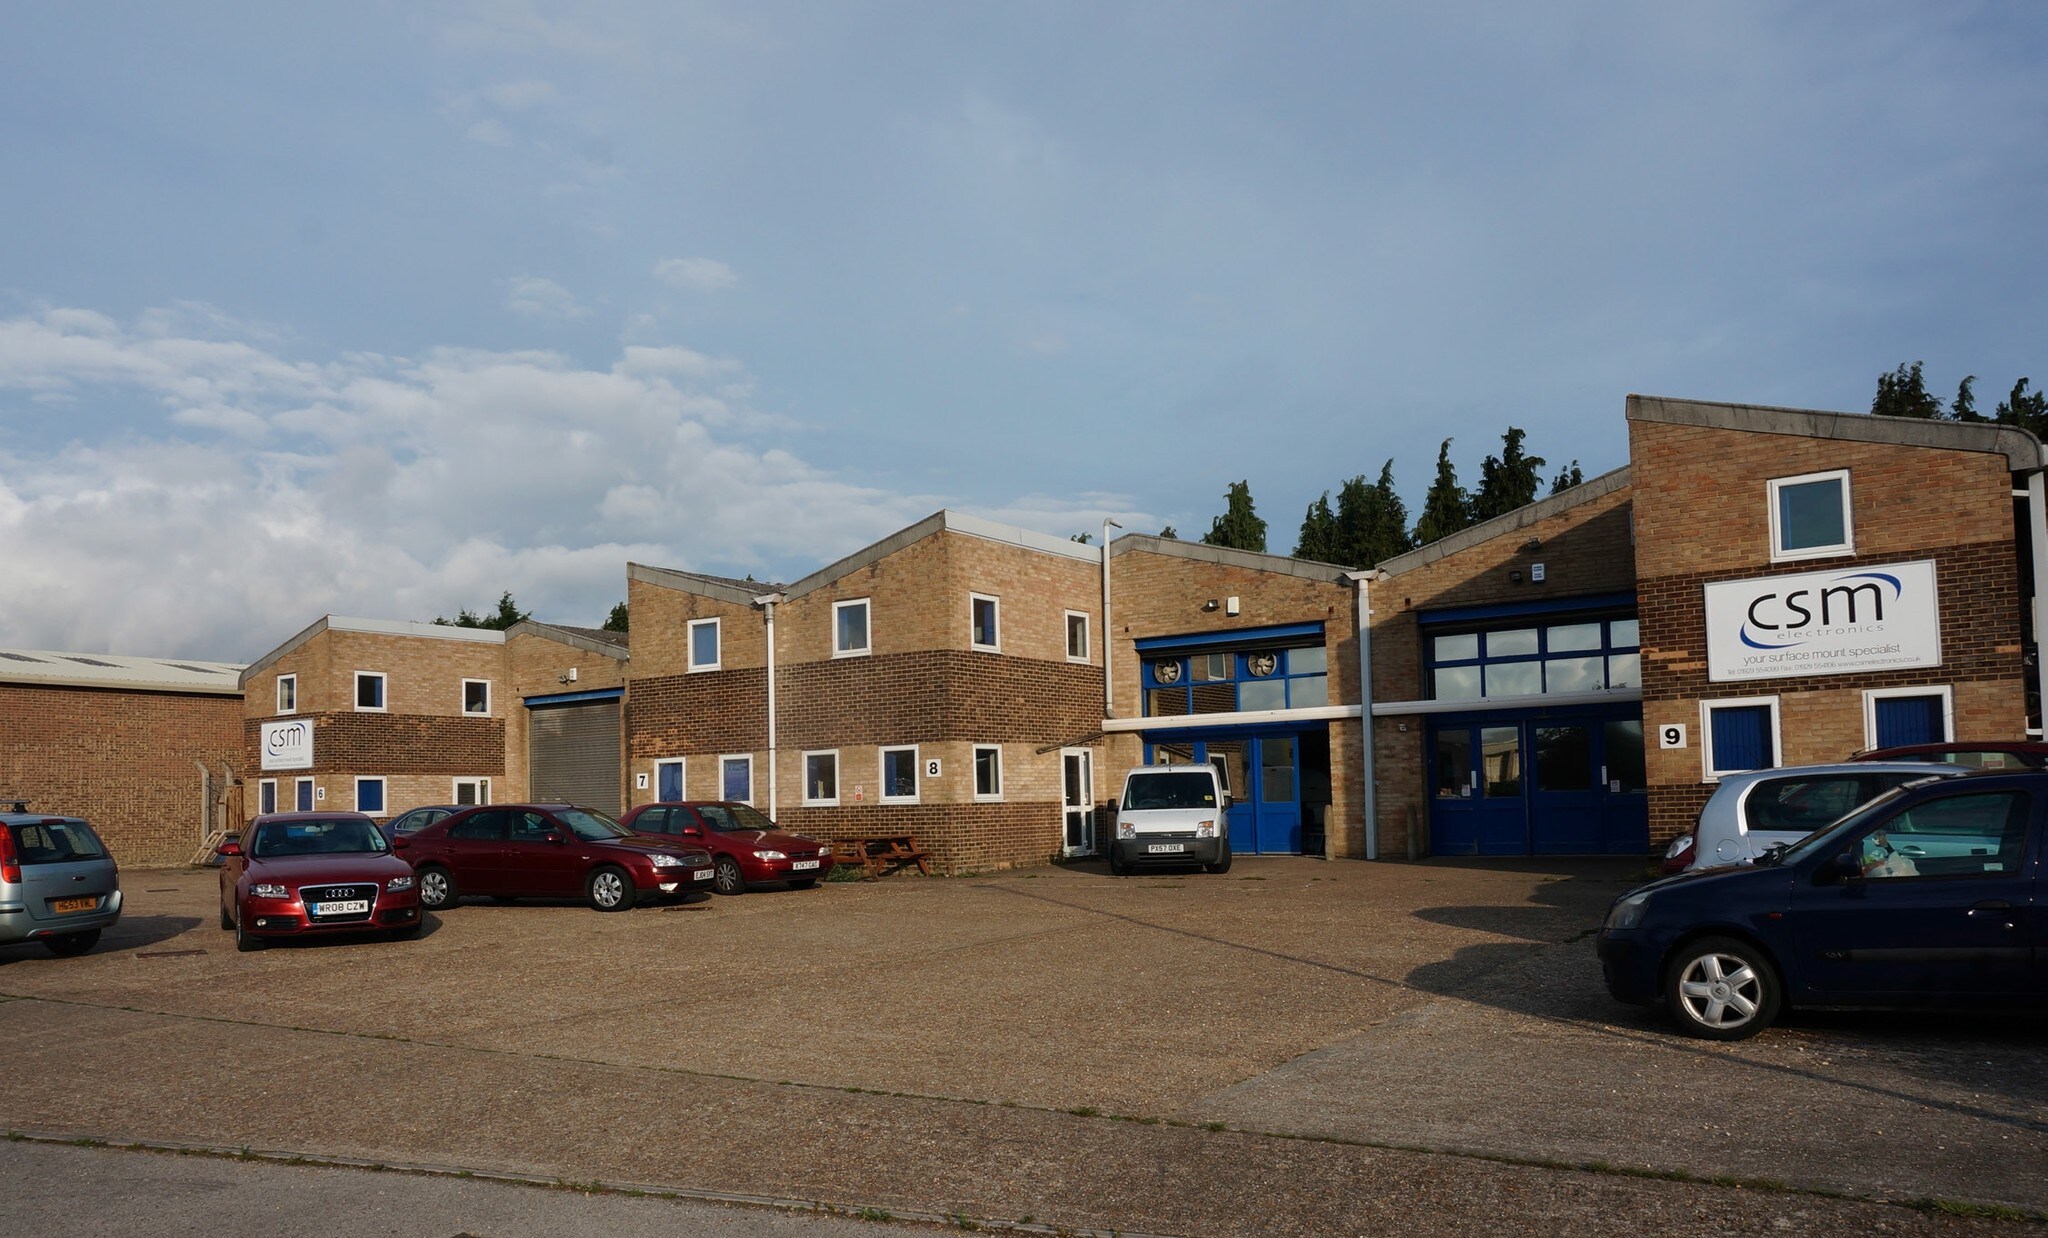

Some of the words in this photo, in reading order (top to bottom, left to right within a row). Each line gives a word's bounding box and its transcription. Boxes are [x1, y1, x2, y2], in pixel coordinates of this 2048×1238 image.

[1777, 624, 1885, 640] electronics
[1743, 655, 1765, 667] your
[1769, 651, 1809, 663] surface
[1812, 648, 1846, 659] mount
[1848, 644, 1901, 658] specialist
[1665, 727, 1680, 745] 9
[929, 761, 938, 775] 8
[639, 775, 646, 787] 7
[318, 788, 324, 799] 6
[319, 903, 344, 912] WR08
[346, 902, 365, 911] CZW
